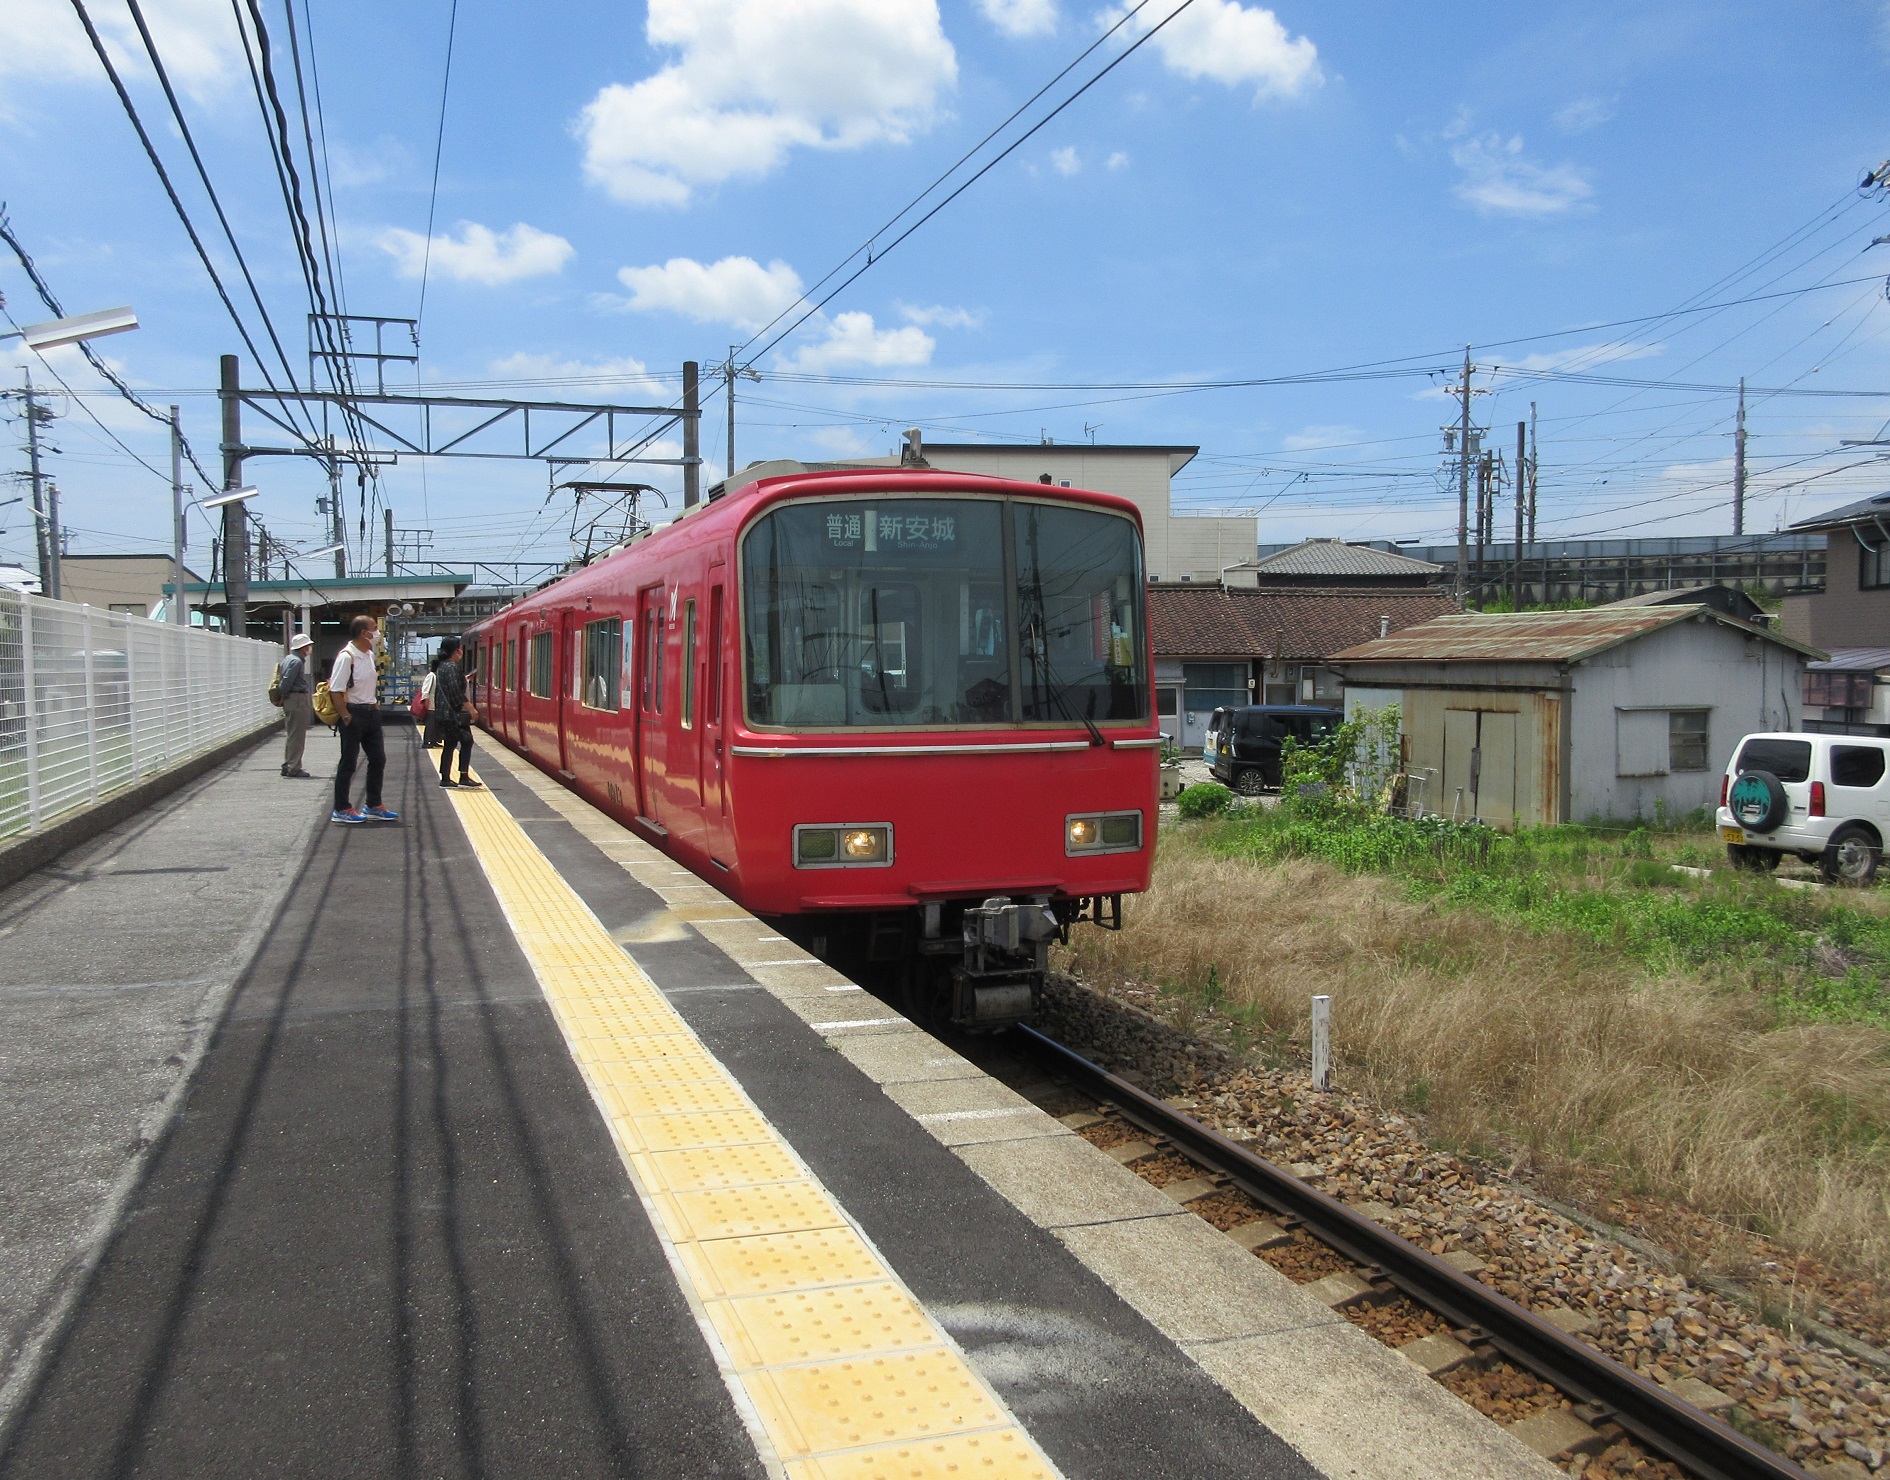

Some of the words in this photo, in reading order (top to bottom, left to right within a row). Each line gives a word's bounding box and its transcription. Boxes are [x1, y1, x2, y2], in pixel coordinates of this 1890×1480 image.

[826, 513, 861, 539] 普通
[880, 515, 955, 541] 新安城
[897, 541, 938, 549] Shin-Anjo
